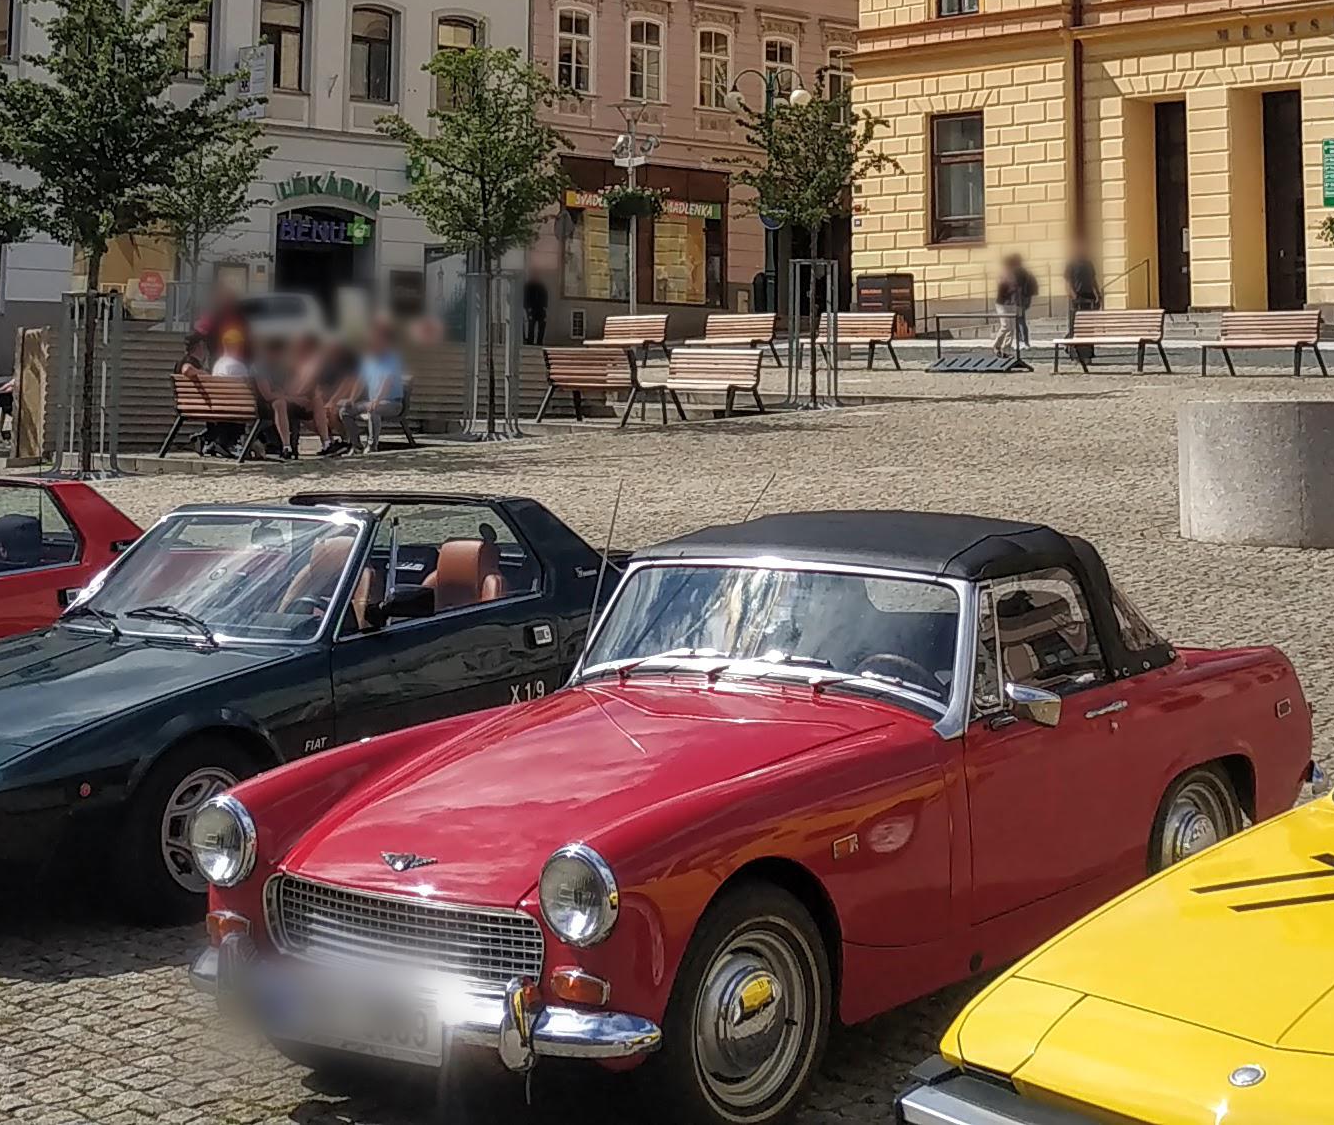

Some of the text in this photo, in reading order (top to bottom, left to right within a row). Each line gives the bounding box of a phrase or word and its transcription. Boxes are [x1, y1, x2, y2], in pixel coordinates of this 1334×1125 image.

[277, 171, 380, 211] LÉKÁRNA
[279, 217, 348, 243] BENU
[510, 680, 545, 704] X 1/9
[304, 737, 328, 752] FIAT
